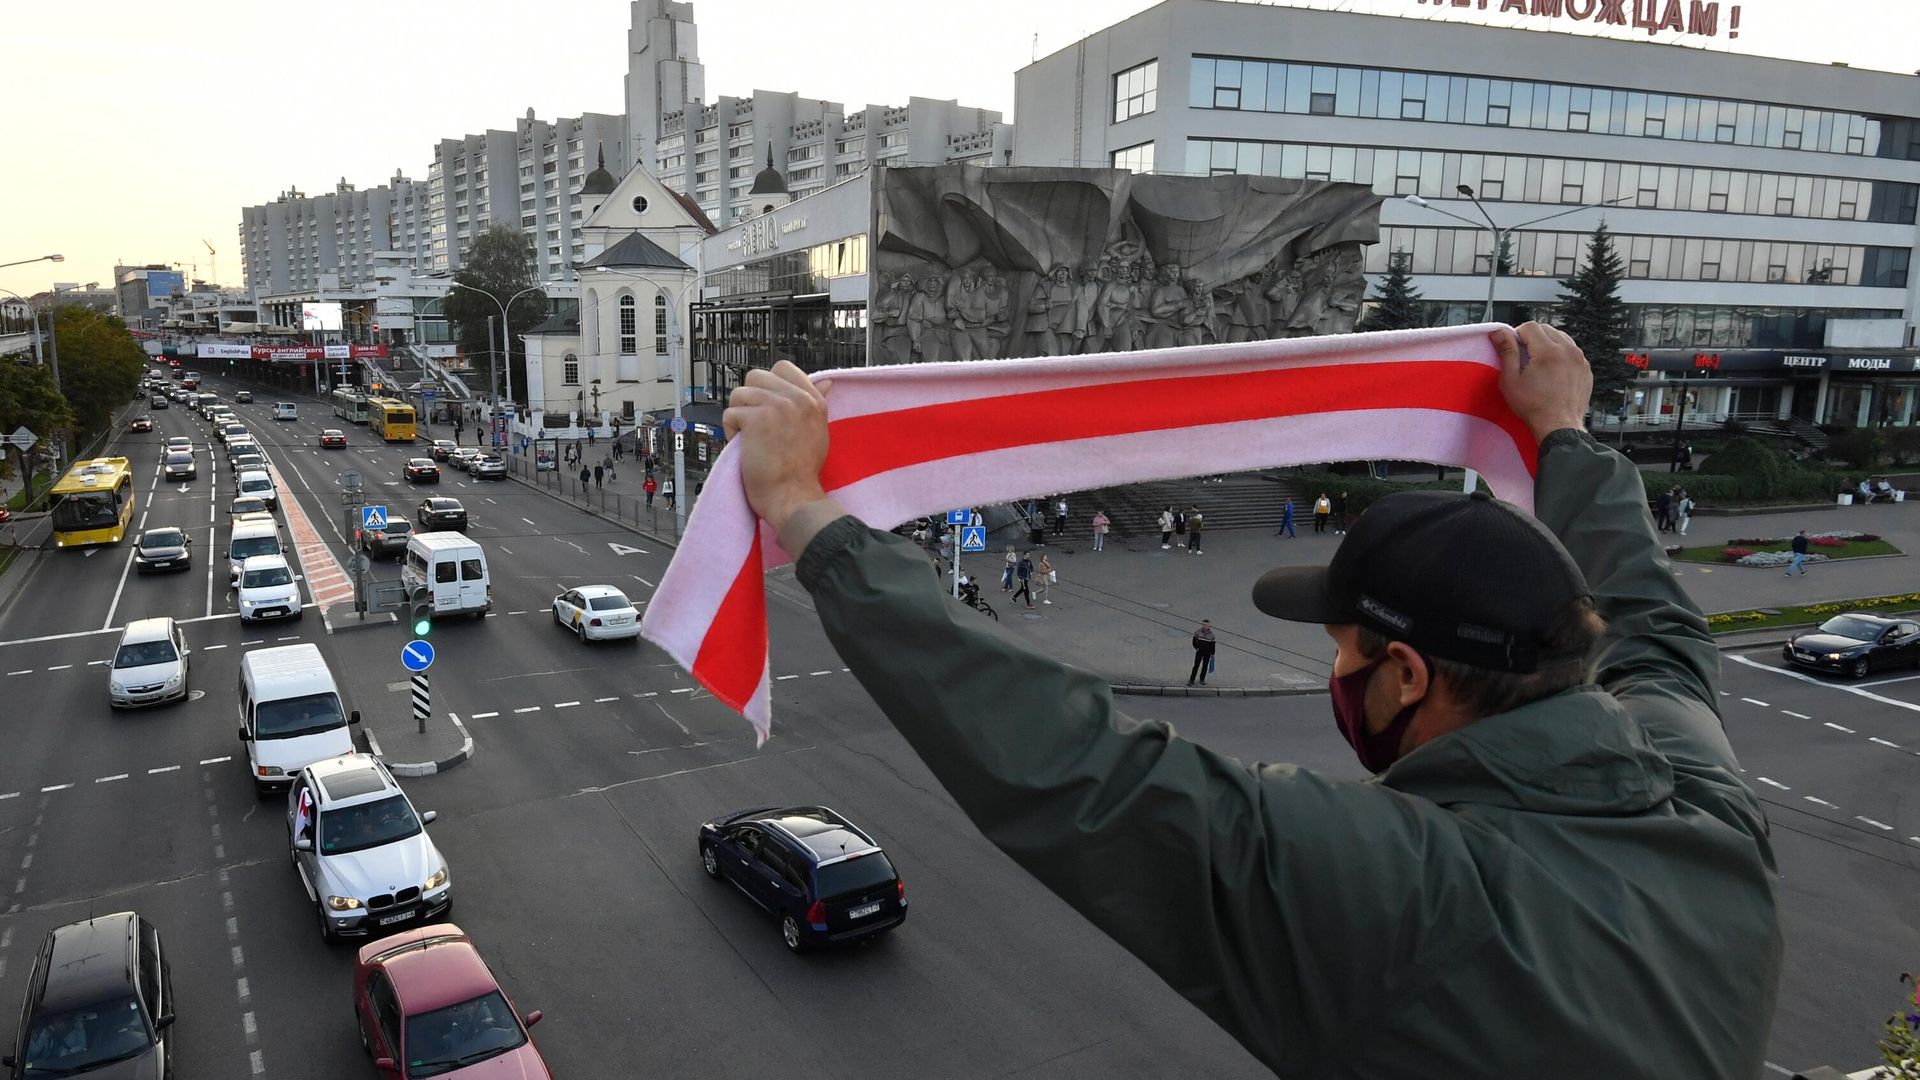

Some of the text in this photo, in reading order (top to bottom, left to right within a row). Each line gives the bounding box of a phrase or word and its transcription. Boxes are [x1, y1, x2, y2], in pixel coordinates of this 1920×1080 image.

[252, 346, 276, 355] Курсы
[1783, 355, 1891, 370] ЦЕНТР МОДЫ
[1369, 602, 1407, 629] Columbia
